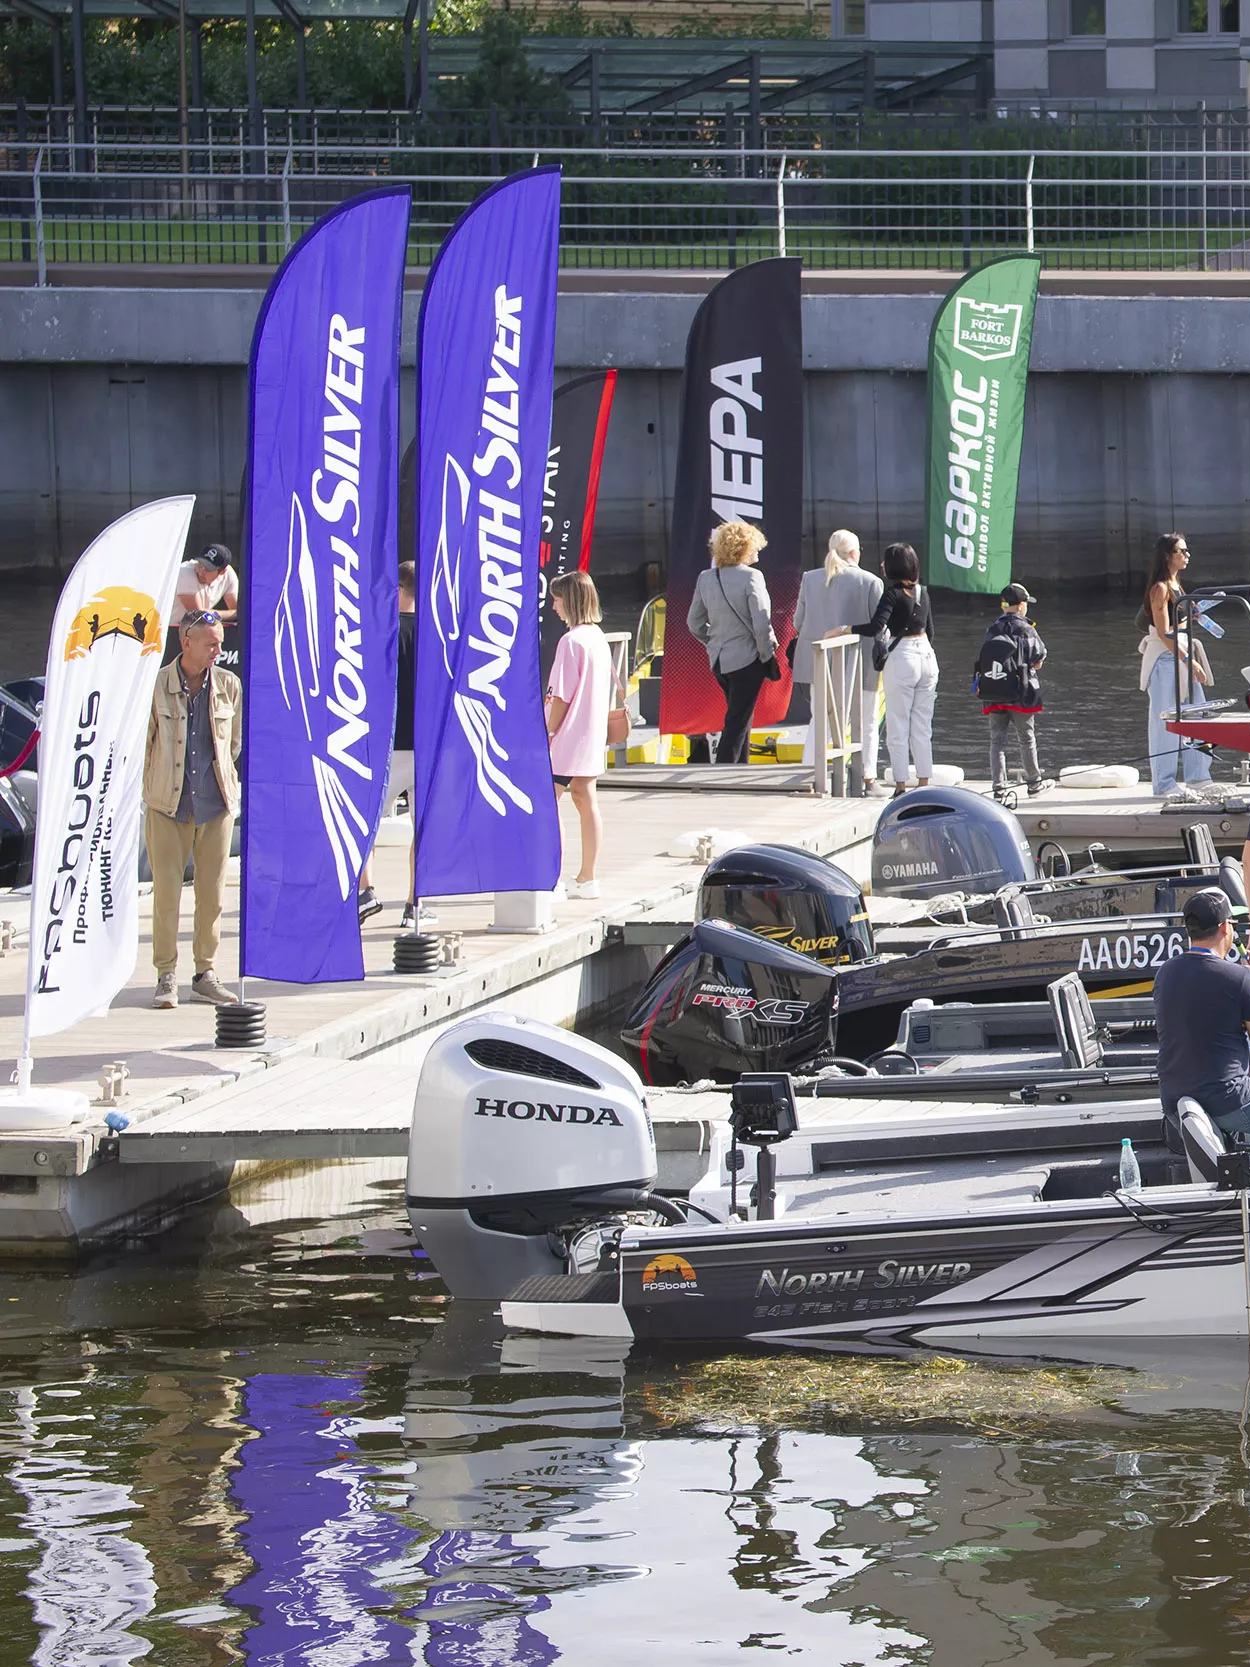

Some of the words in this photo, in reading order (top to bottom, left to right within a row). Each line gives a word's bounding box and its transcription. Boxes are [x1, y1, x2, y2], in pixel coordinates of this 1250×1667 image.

[961, 329, 1011, 346] BARKOS
[971, 319, 1004, 331] FORT
[472, 284, 522, 490] SILVER
[311, 313, 366, 538] SILVER
[557, 519, 571, 574] HTING
[468, 488, 523, 712] NORTH
[326, 534, 373, 780] NORTH
[893, 861, 939, 878] YAMAHA
[790, 936, 839, 952] SILVER
[700, 983, 752, 996] MERCURY
[474, 1098, 624, 1127] HONDA
[643, 1281, 698, 1291] FPSboats
[755, 1268, 864, 1298] NORTH
[874, 1260, 971, 1288] SILVER
